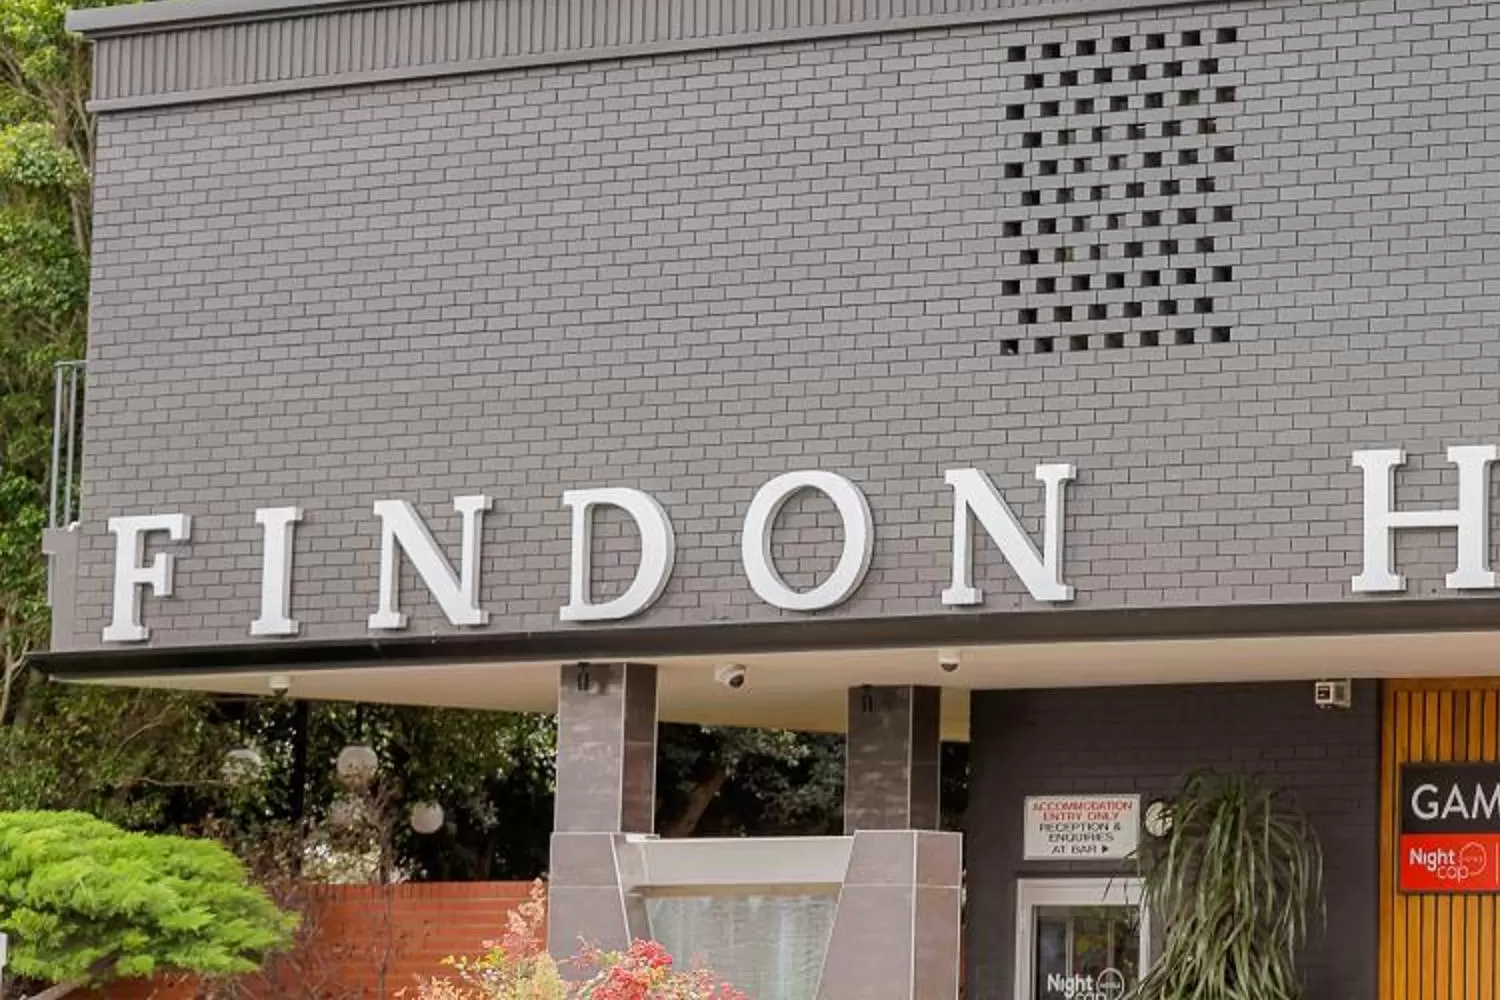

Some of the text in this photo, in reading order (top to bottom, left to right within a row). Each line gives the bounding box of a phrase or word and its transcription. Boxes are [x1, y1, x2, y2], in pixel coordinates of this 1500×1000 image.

[102, 463, 1076, 642] FINDON
[1032, 801, 1132, 812] ACCOMMODATION
[1043, 811, 1120, 821] ENTRY ONLY
[1039, 822, 1109, 832] RECEPTION
[1048, 832, 1115, 842] ENQUIRIES
[1051, 845, 1097, 854] AT BAR
[1409, 848, 1455, 871] Night
[1437, 865, 1469, 883] cap
[1047, 973, 1093, 1000] Night
